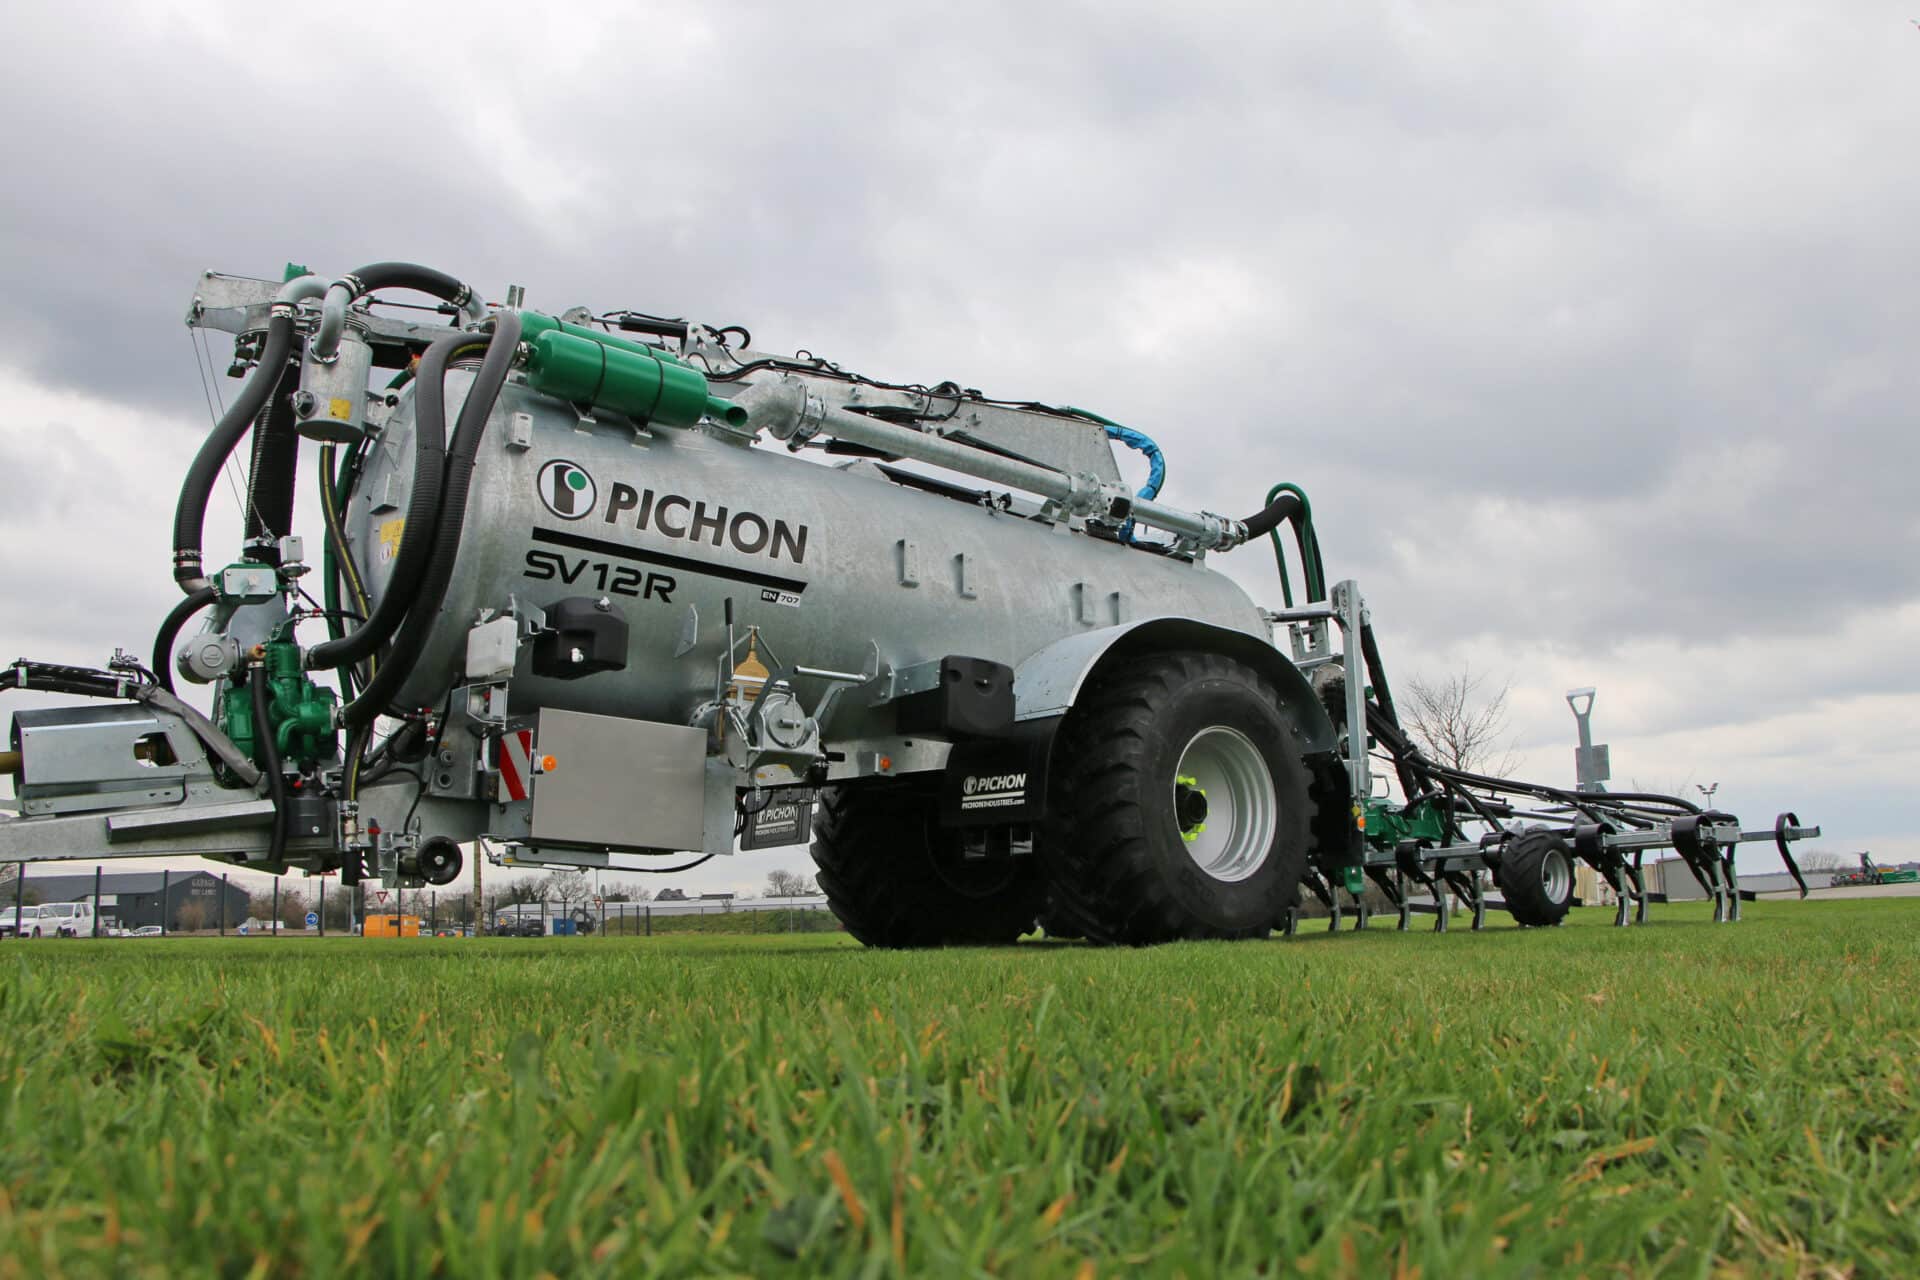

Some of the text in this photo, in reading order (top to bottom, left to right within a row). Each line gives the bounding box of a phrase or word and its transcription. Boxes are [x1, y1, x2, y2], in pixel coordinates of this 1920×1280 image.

[604, 481, 808, 564] PICHON
[522, 550, 677, 603] SV12R
[762, 591, 800, 604] EN 707
[977, 773, 1027, 792] PICHON
[765, 806, 799, 822] PICHON
